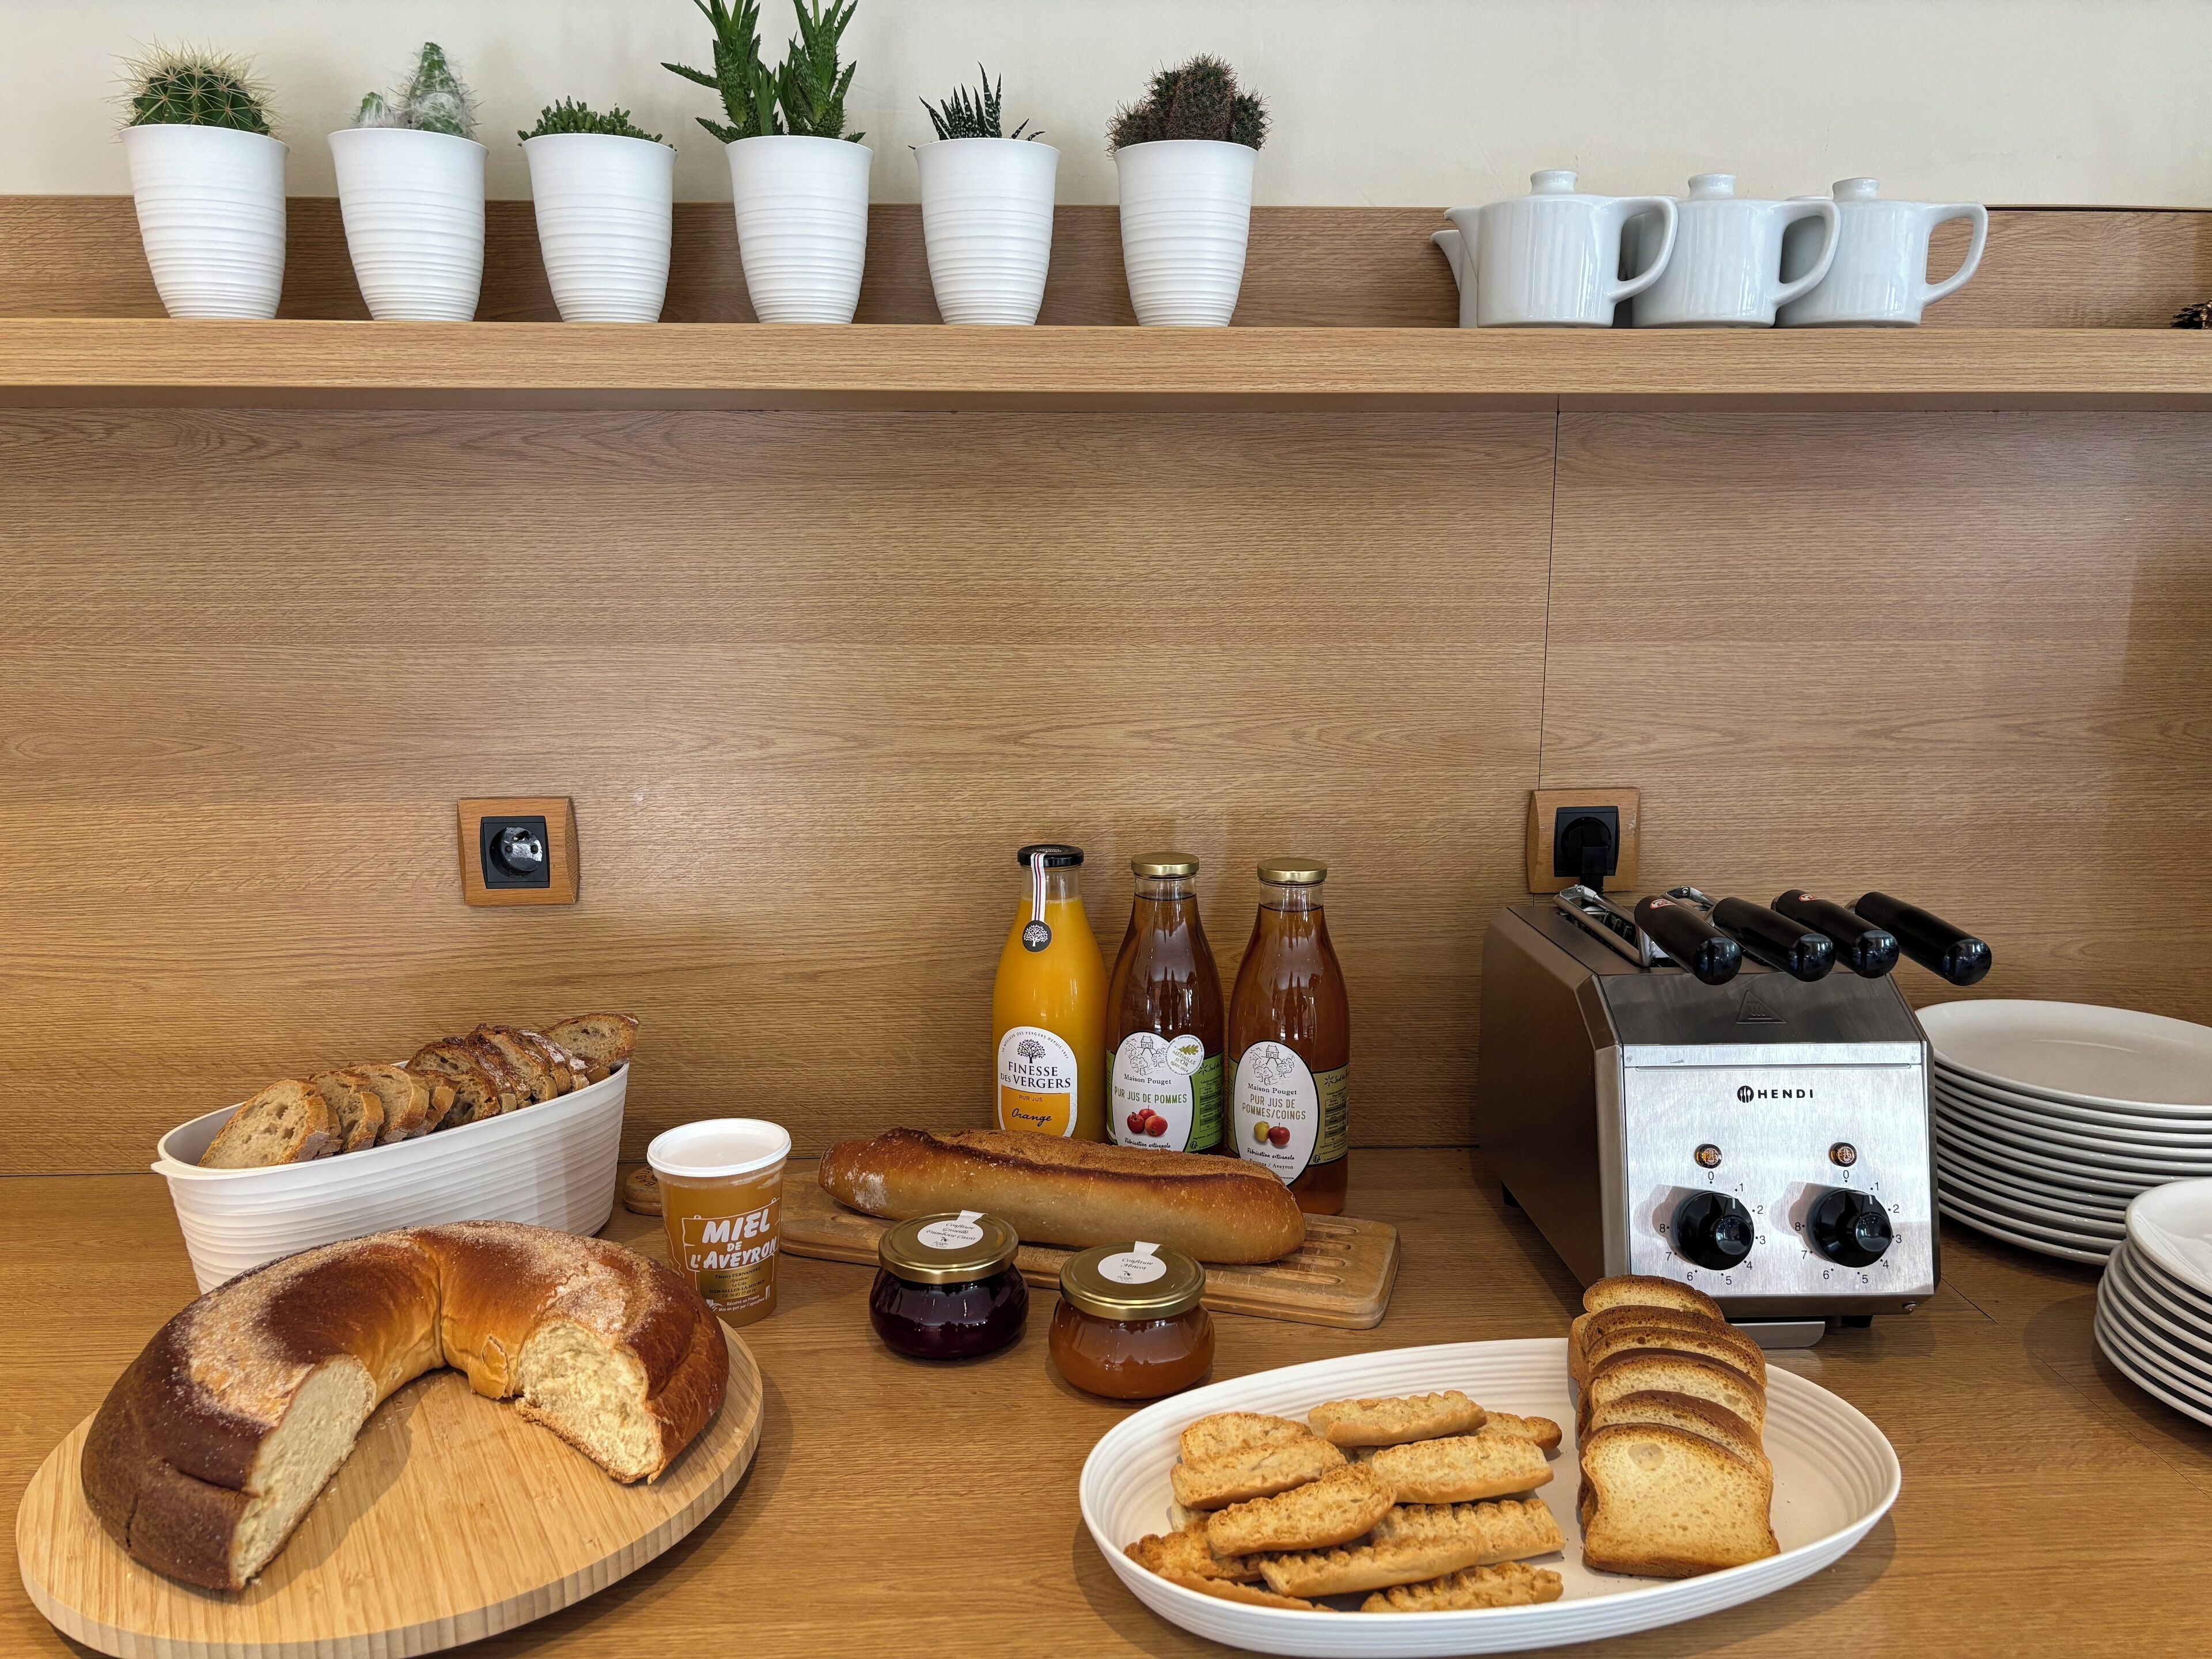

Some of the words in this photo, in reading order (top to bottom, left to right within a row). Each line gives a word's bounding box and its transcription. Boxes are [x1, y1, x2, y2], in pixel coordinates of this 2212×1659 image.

[1047, 1037, 1062, 1049] DEPUIS
[1175, 1058, 1188, 1067] D'OR
[1009, 1061, 1058, 1077] FINESSE
[1001, 1073, 1011, 1083] DES
[1013, 1074, 1071, 1089] VERGERS
[1124, 1074, 1145, 1083] Maison
[1248, 1082, 1270, 1093] Maison
[1272, 1088, 1297, 1096] Pouget
[1758, 1089, 1813, 1099] HENDI
[1115, 1086, 1125, 1099] PUR
[1127, 1090, 1140, 1101] JUS
[1143, 1093, 1152, 1103] DE
[1154, 1094, 1187, 1104] POMMES
[1250, 1093, 1264, 1106] PUR
[1267, 1097, 1283, 1108] JUS
[1286, 1099, 1296, 1109] DE
[1242, 1103, 1306, 1120] POMMES/COINGS
[1012, 1108, 1052, 1127] Orange
[1124, 1137, 1147, 1147] Fabrication
[1247, 1147, 1270, 1158] Fabrication
[1707, 1171, 1714, 1180] 0
[1843, 1170, 1850, 1179] 0
[1739, 1182, 1744, 1192] 1
[1874, 1181, 1879, 1191] 1
[1757, 1205, 1763, 1214] 2
[1893, 1204, 1900, 1213] 2
[702, 1208, 770, 1244] MIEL
[1659, 1223, 1666, 1233] 8
[1794, 1222, 1801, 1232] 8
[1759, 1235, 1766, 1244] 3
[1895, 1234, 1902, 1243] 3
[726, 1240, 743, 1252] DE
[690, 1236, 777, 1269] L'AVEYRON
[1665, 1251, 1672, 1261] 7
[1801, 1249, 1808, 1260] 7
[1122, 1257, 1154, 1266] Confiture
[1746, 1261, 1753, 1270] 4
[1883, 1260, 1889, 1268] 4
[732, 1266, 762, 1278] FERNANDEZ
[1687, 1271, 1693, 1281] 6
[1823, 1270, 1830, 1279] 6
[1725, 1275, 1732, 1285] 5
[1862, 1274, 1869, 1284] 5
[748, 1294, 760, 1302] France
